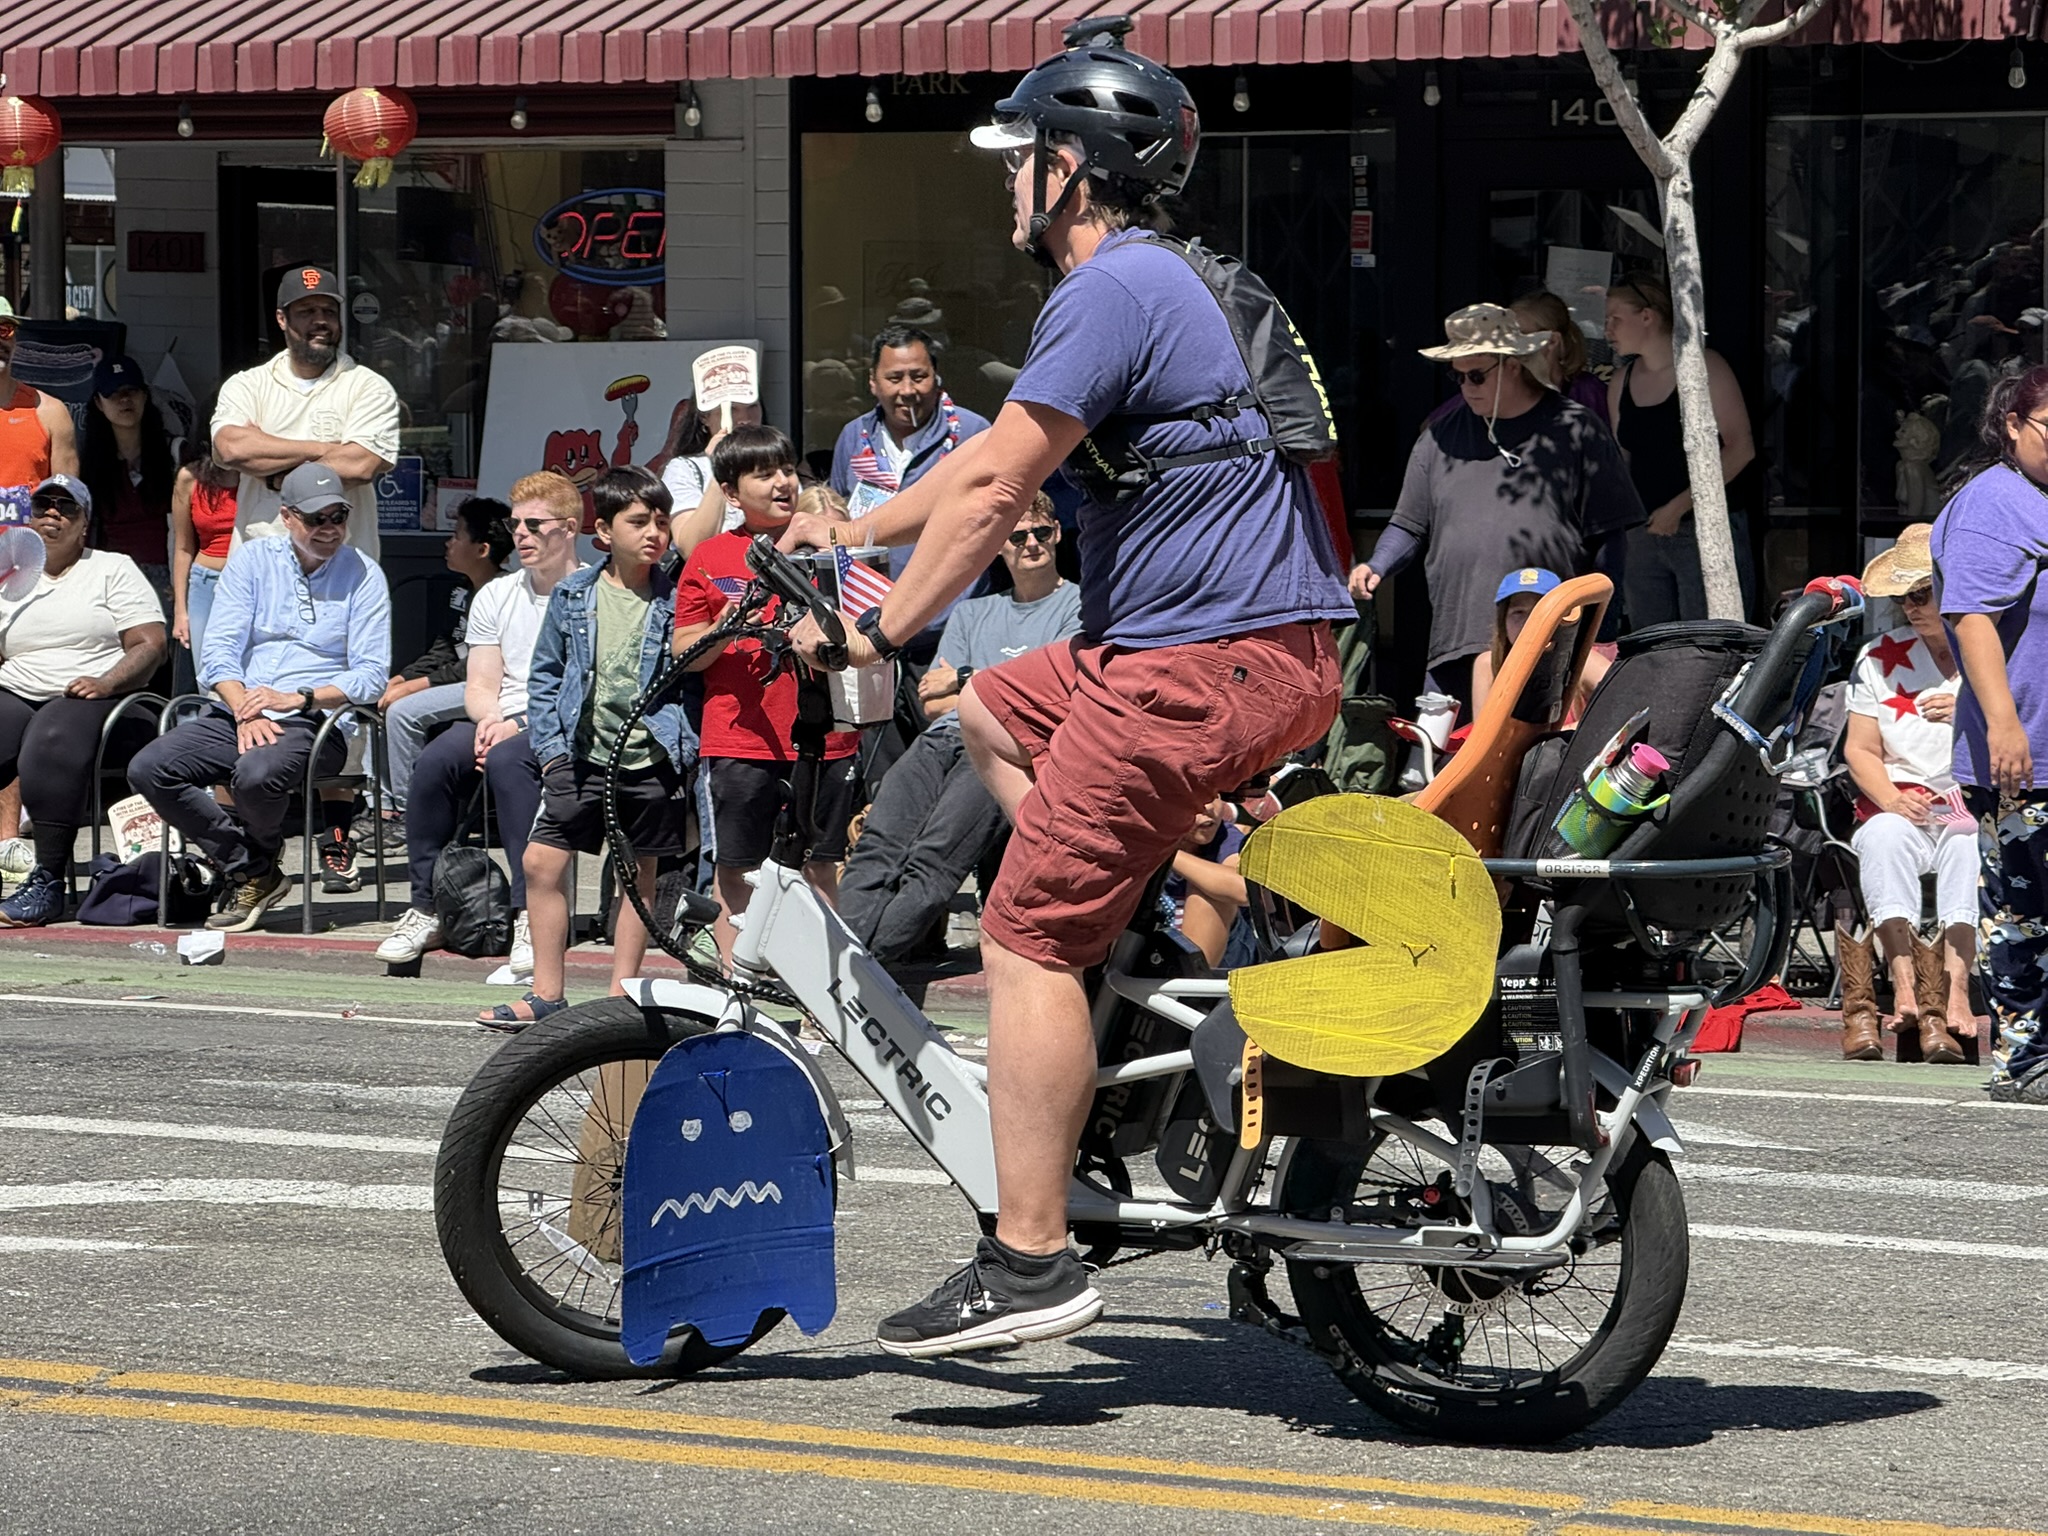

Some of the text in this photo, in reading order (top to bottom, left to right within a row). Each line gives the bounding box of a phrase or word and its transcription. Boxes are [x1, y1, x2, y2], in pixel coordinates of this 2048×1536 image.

[892, 73, 969, 95] PARK
[137, 235, 195, 269] 1401
[1083, 437, 1119, 481] ATHAN
[1501, 977, 1526, 988] Yepp
[826, 977, 952, 1121] LECTRIC
[1634, 1044, 1661, 1087] XPEDITION
